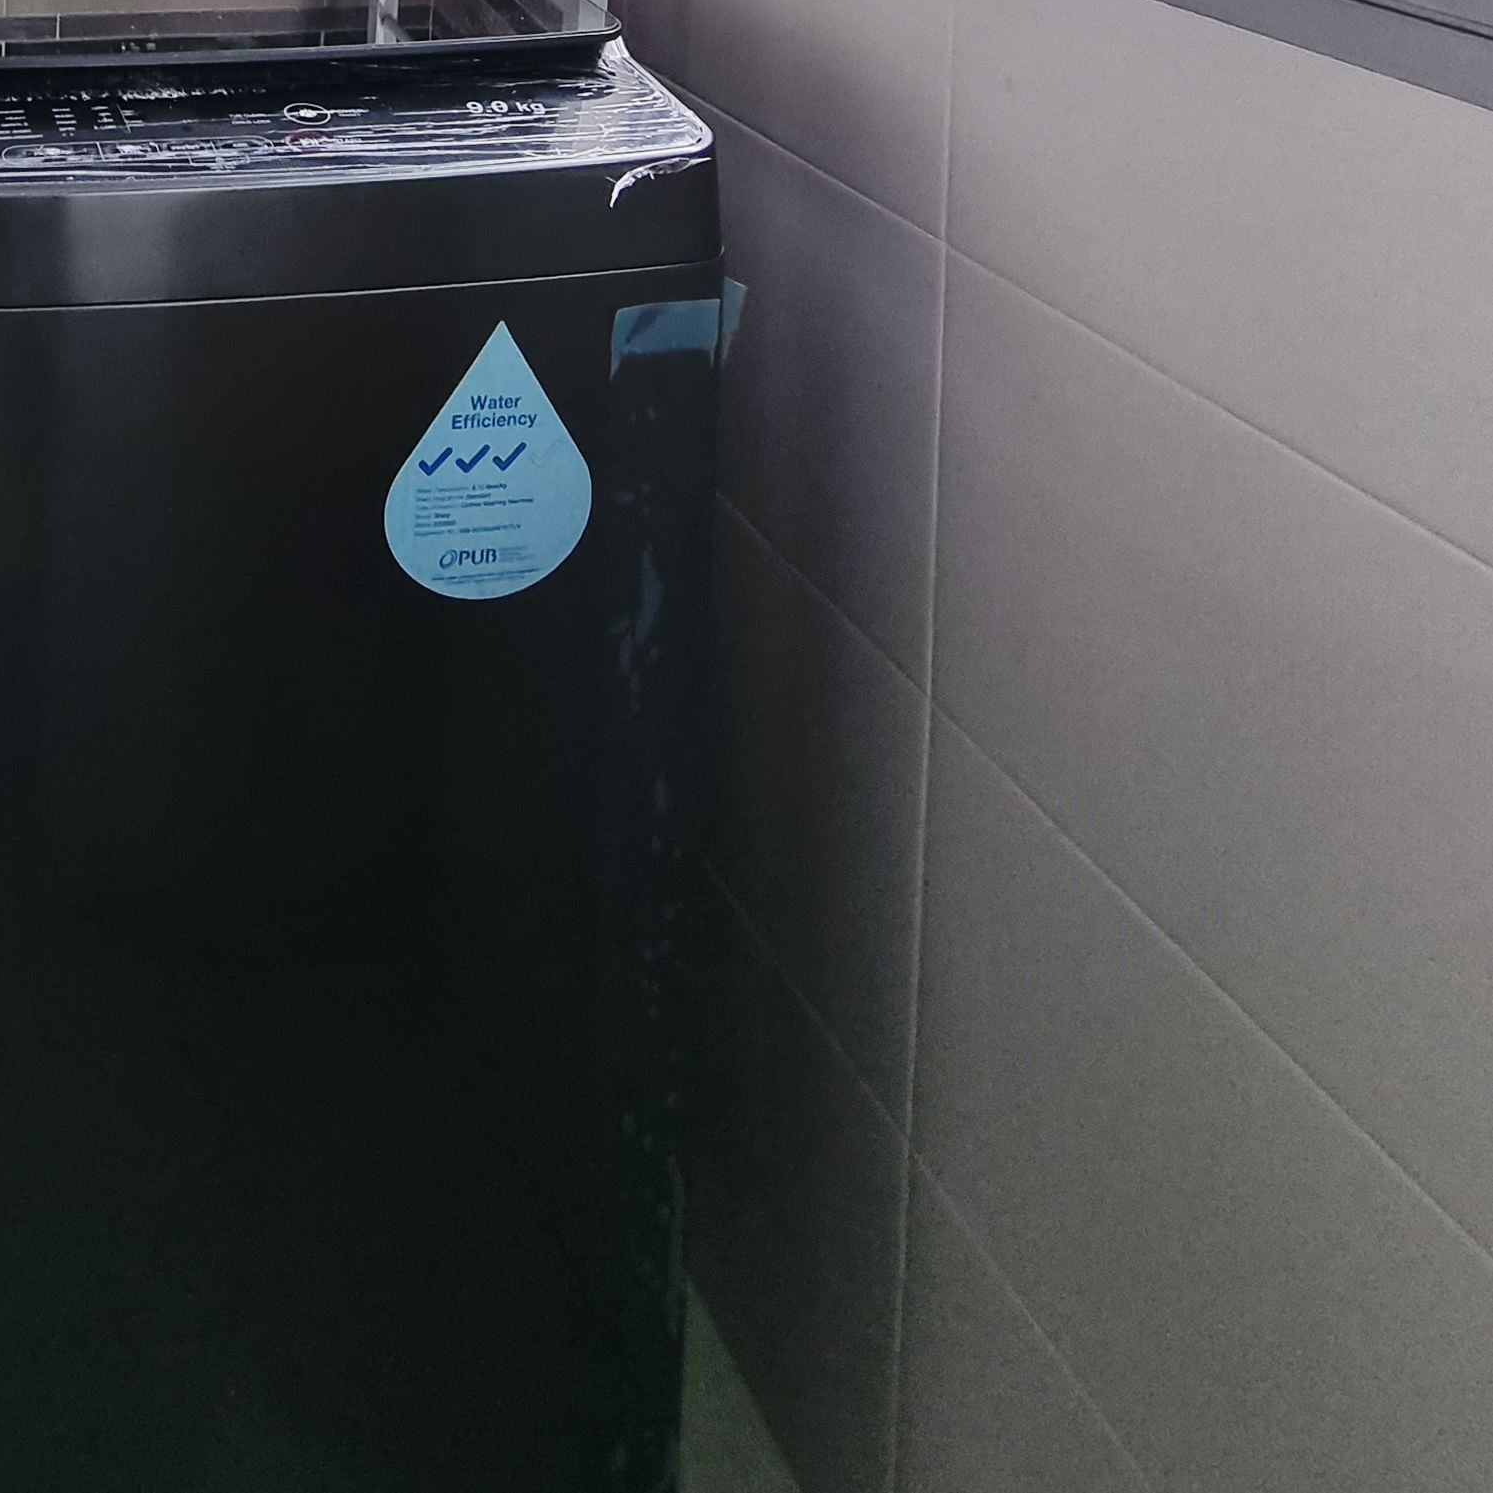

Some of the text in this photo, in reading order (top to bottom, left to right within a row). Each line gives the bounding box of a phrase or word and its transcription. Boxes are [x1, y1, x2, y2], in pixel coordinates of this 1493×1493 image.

[515, 101, 546, 115] kg
[471, 395, 522, 411] Water
[451, 413, 538, 430] Efficiency
[458, 548, 497, 566] PUB
